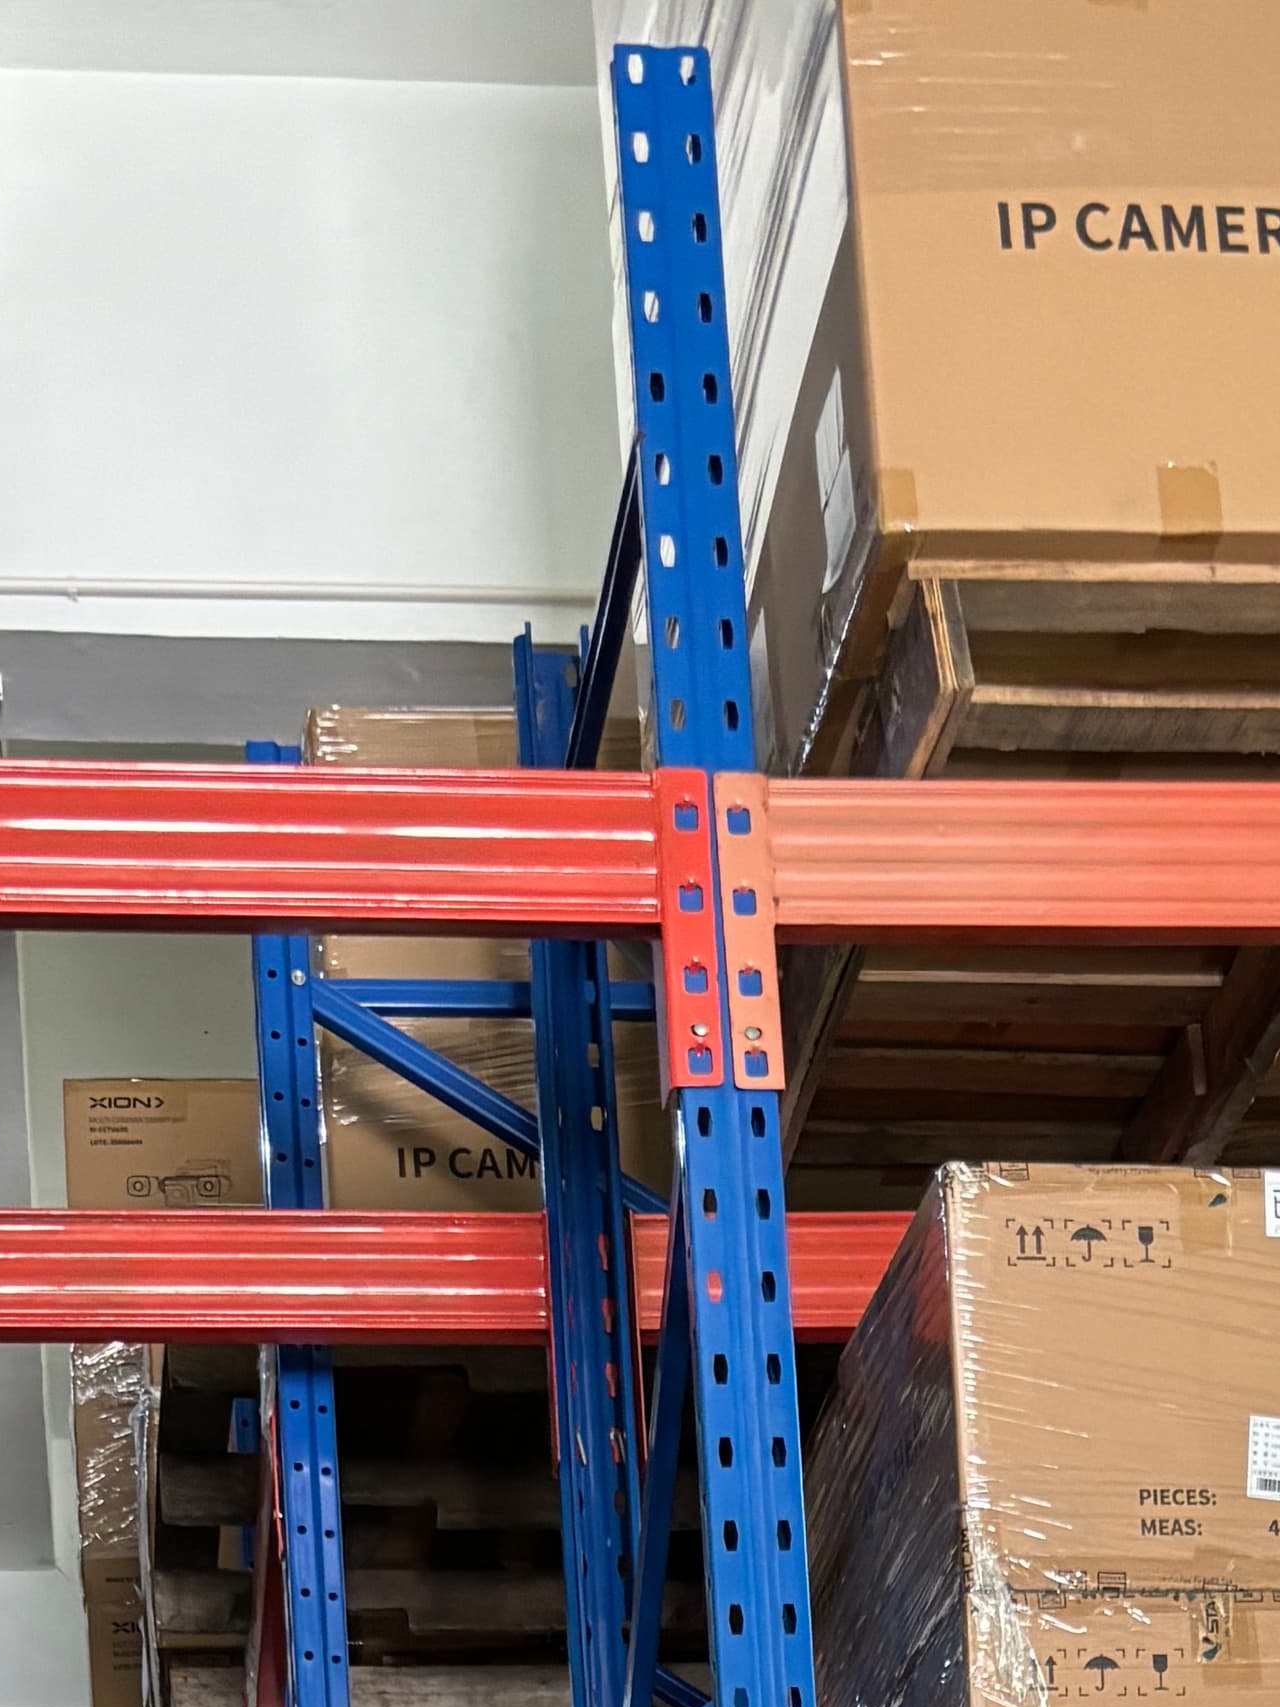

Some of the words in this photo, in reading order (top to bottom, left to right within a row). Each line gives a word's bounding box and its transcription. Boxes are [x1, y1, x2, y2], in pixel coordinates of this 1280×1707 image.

[997, 203, 1058, 250] IP
[398, 1148, 436, 1181] IP
[448, 1146, 537, 1181] CAM
[1139, 1488, 1217, 1506] PIECES:
[1141, 1519, 1202, 1536] MEAS:
